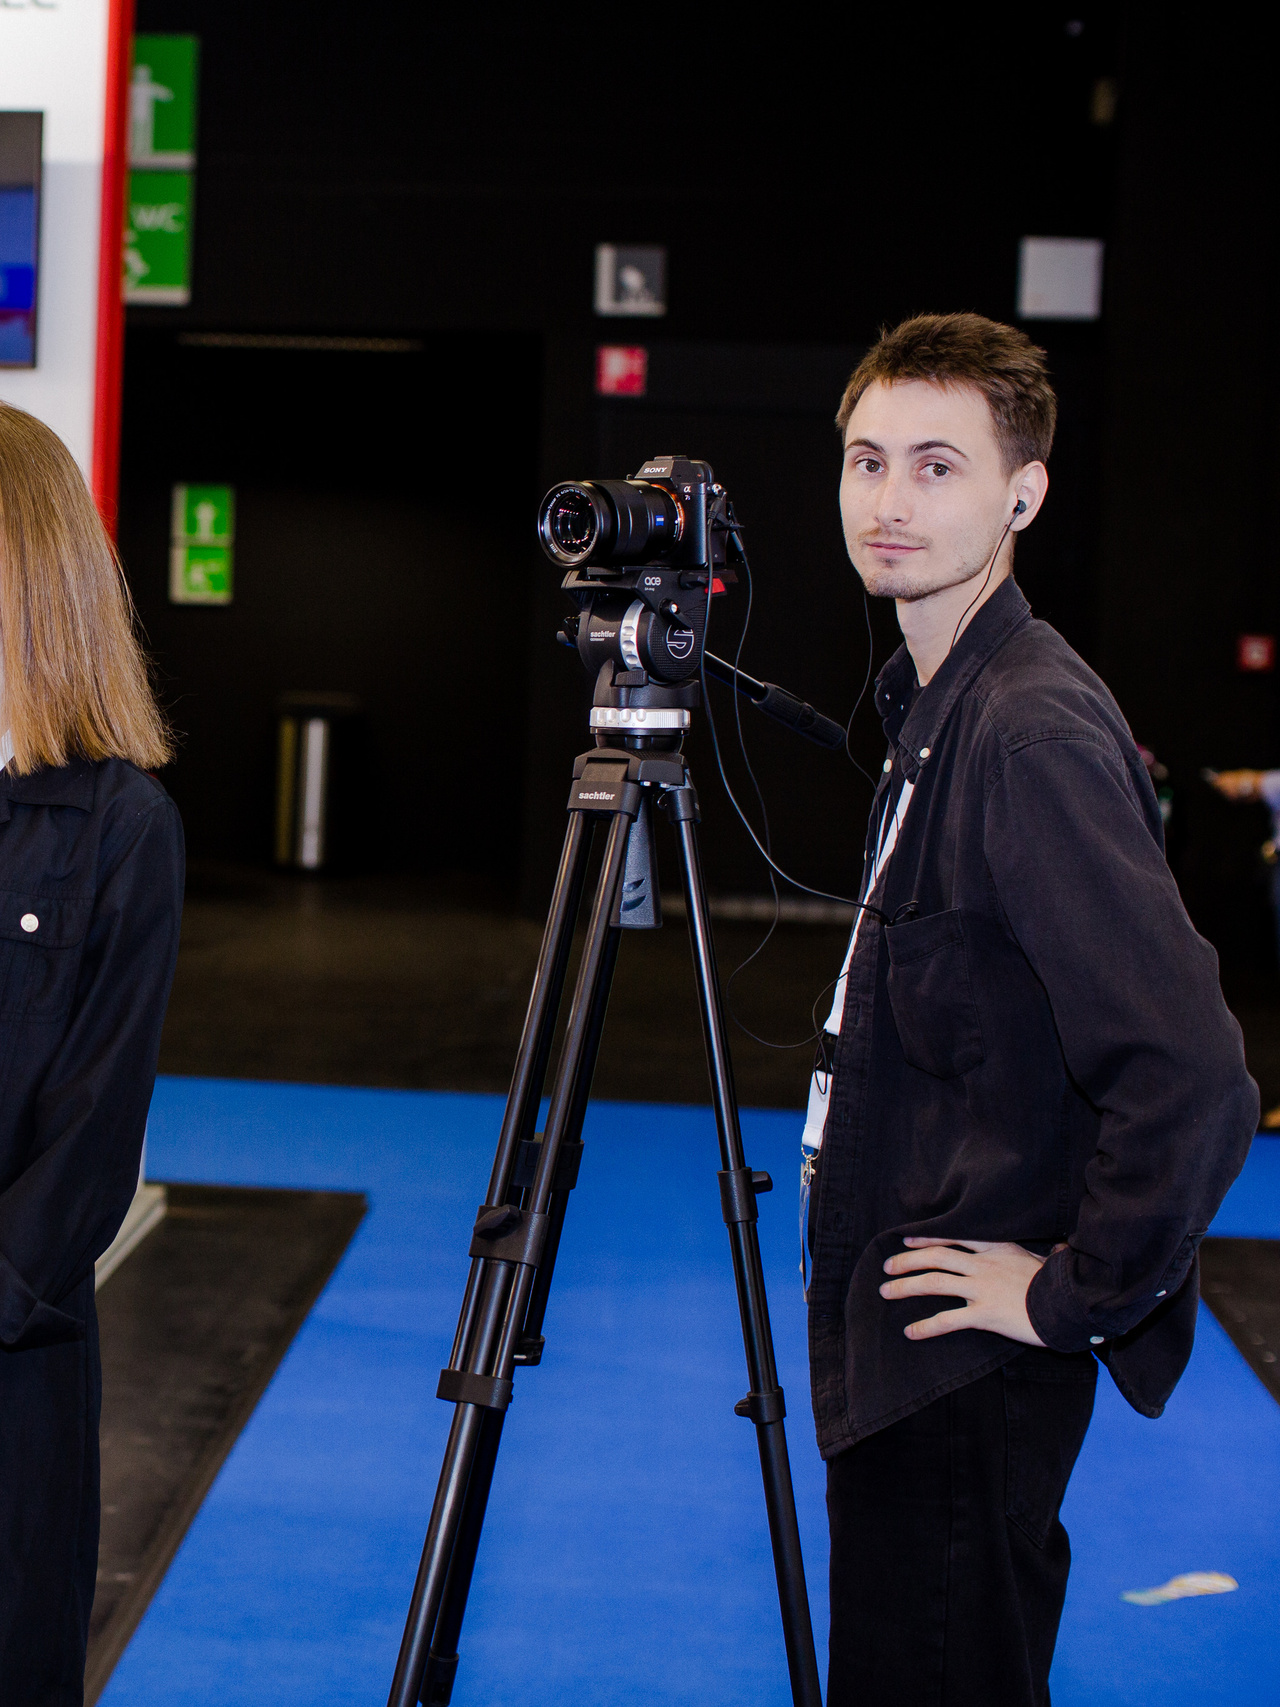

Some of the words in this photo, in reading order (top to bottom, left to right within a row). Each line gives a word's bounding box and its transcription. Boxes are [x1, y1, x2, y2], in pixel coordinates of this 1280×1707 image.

[129, 203, 184, 232] WC
[643, 466, 668, 474] SONY
[644, 576, 661, 586] ace
[590, 630, 616, 638] sachtler
[578, 791, 615, 801] sachtler
